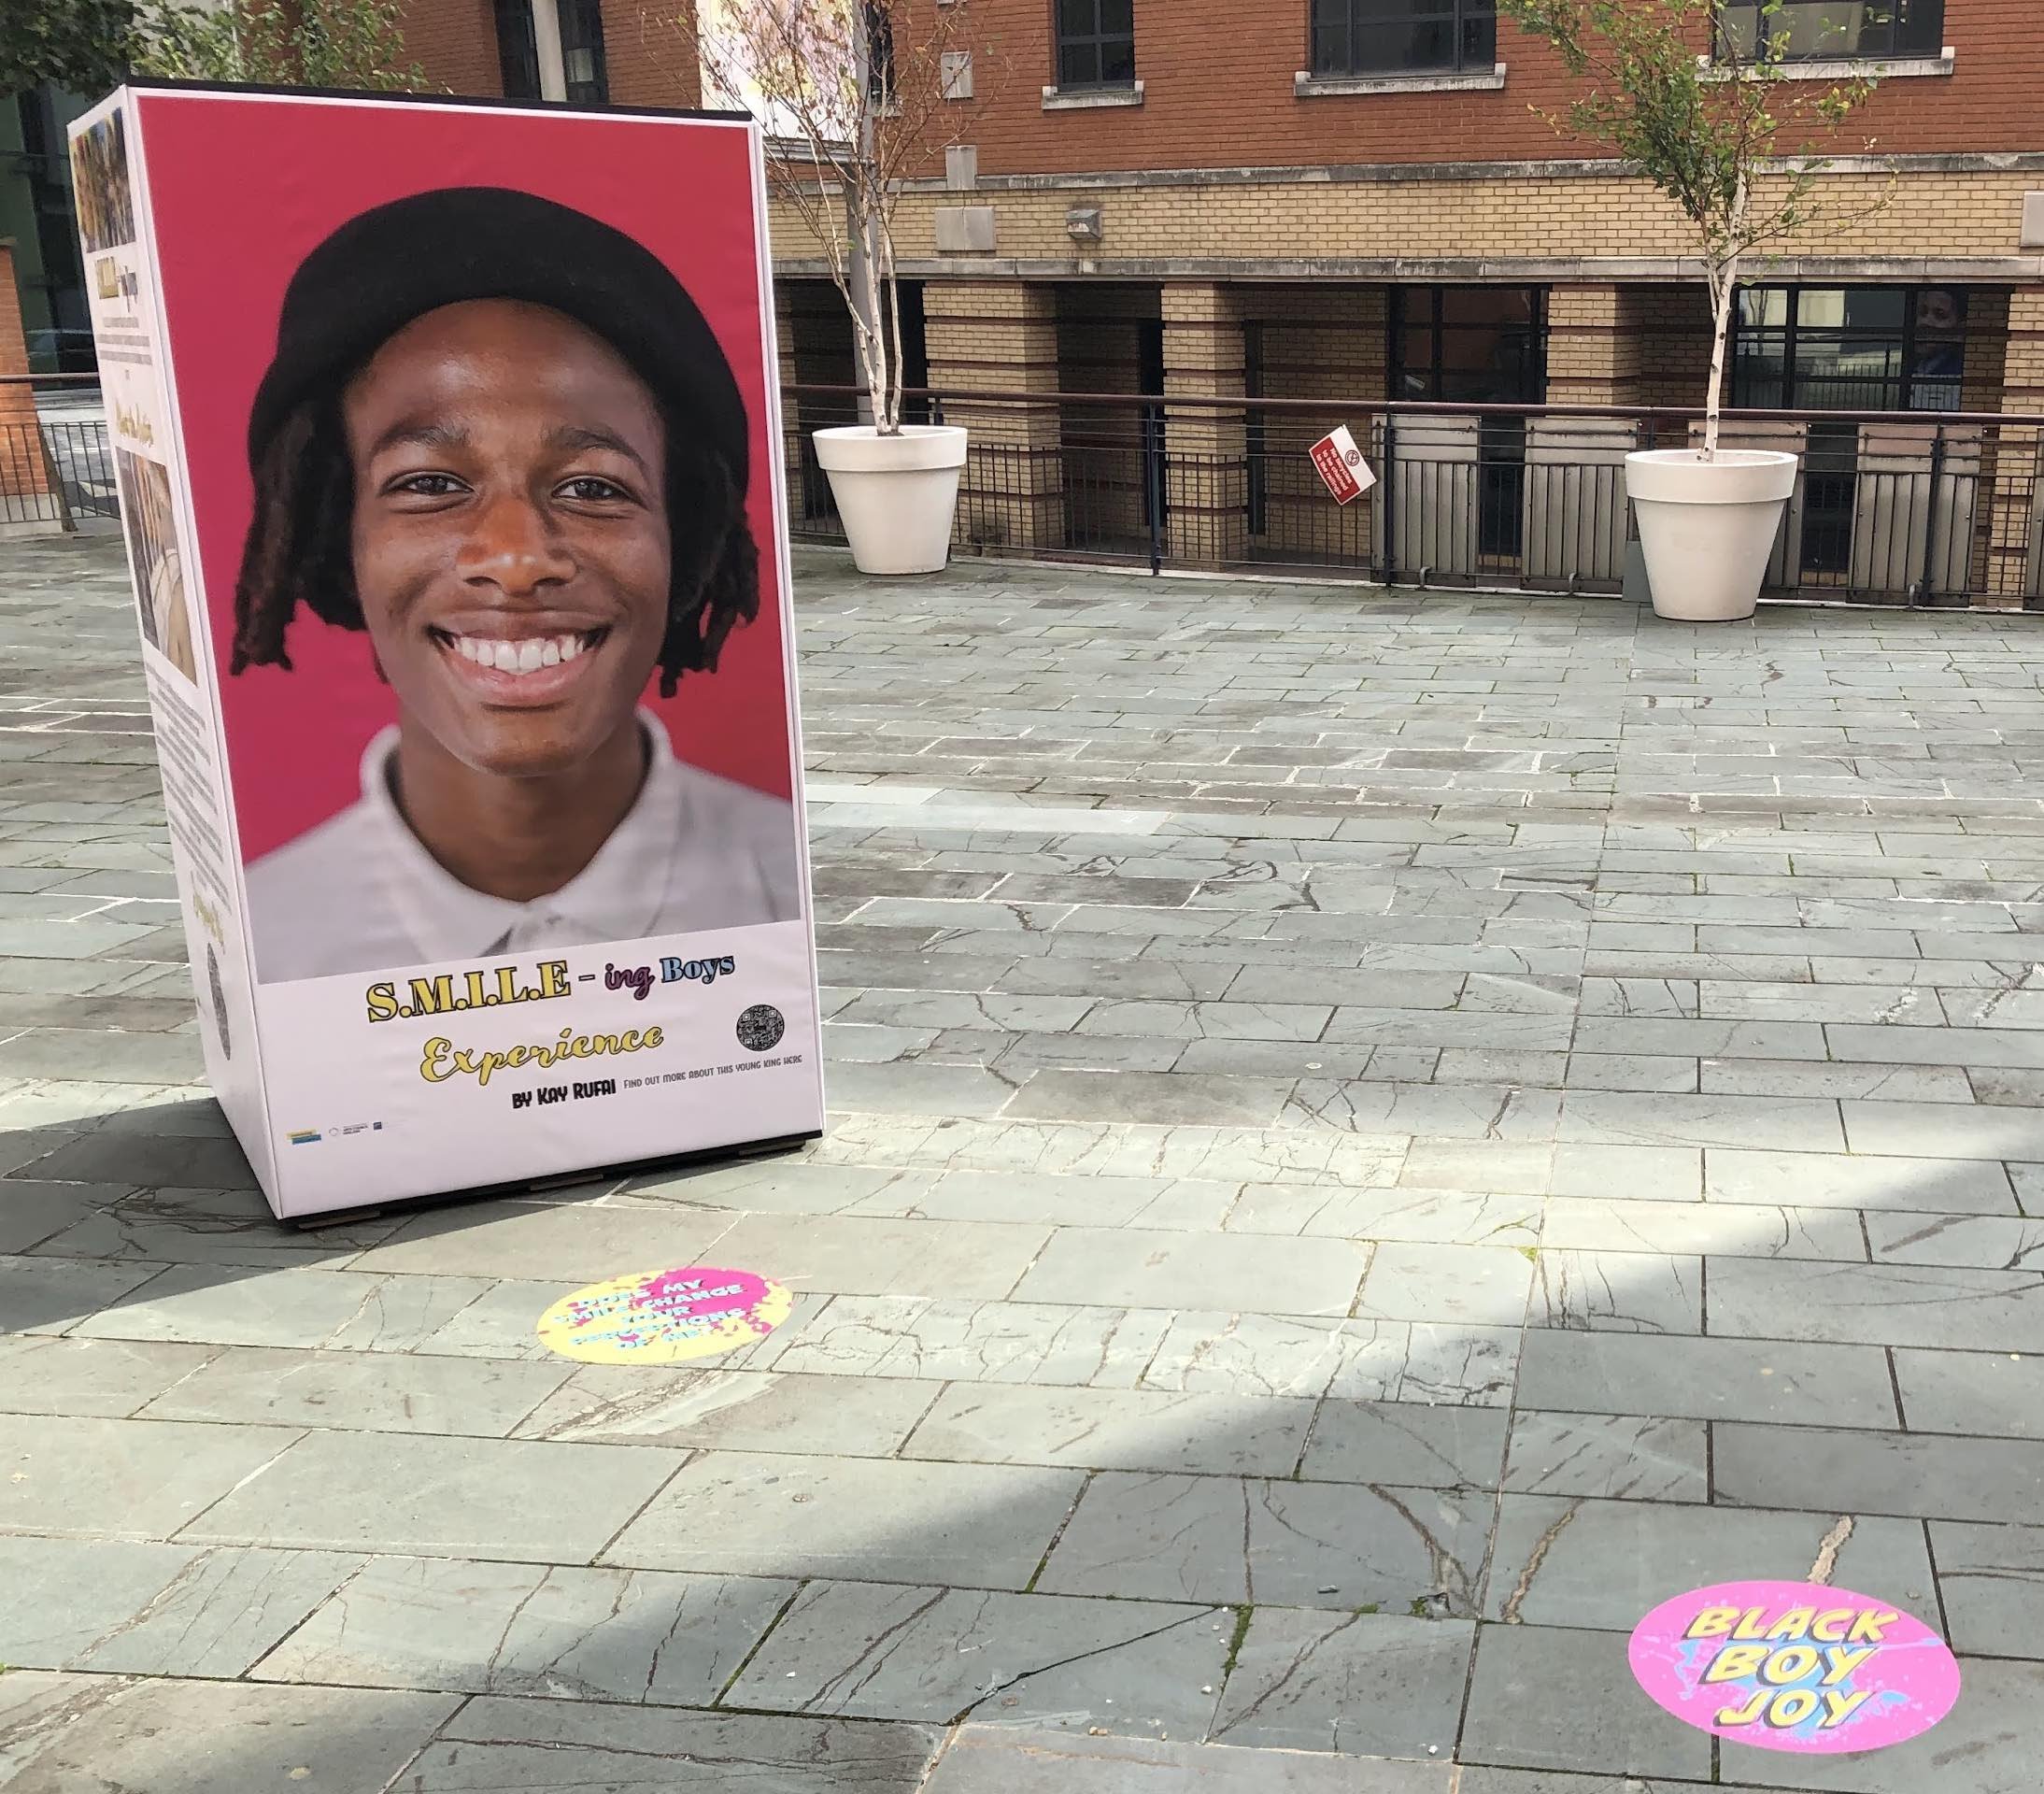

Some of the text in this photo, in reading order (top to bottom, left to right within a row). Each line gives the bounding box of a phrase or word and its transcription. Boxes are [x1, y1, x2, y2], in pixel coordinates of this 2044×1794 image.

[1315, 453, 1322, 462] to
[1327, 472, 1342, 495] railings
[1323, 449, 1349, 491] to be chained
[1330, 448, 1353, 484] No bicycles
[366, 959, 571, 1022] S.M.I.L.E
[604, 962, 655, 1001] ing
[660, 955, 735, 984] Boys
[419, 1026, 664, 1086] Experience
[623, 1055, 802, 1089] FIND OUT MORE ABOUT THIS YOUNG KING HERE
[511, 1079, 617, 1109] BY KAY RUFAI
[578, 1278, 703, 1306] DOES MY
[641, 1284, 747, 1308] CHANGE
[619, 1305, 692, 1325] YOUR
[1682, 1606, 1900, 1643] BLACK
[1697, 1644, 1879, 1686] BOY
[1713, 1688, 1877, 1729] JOY
